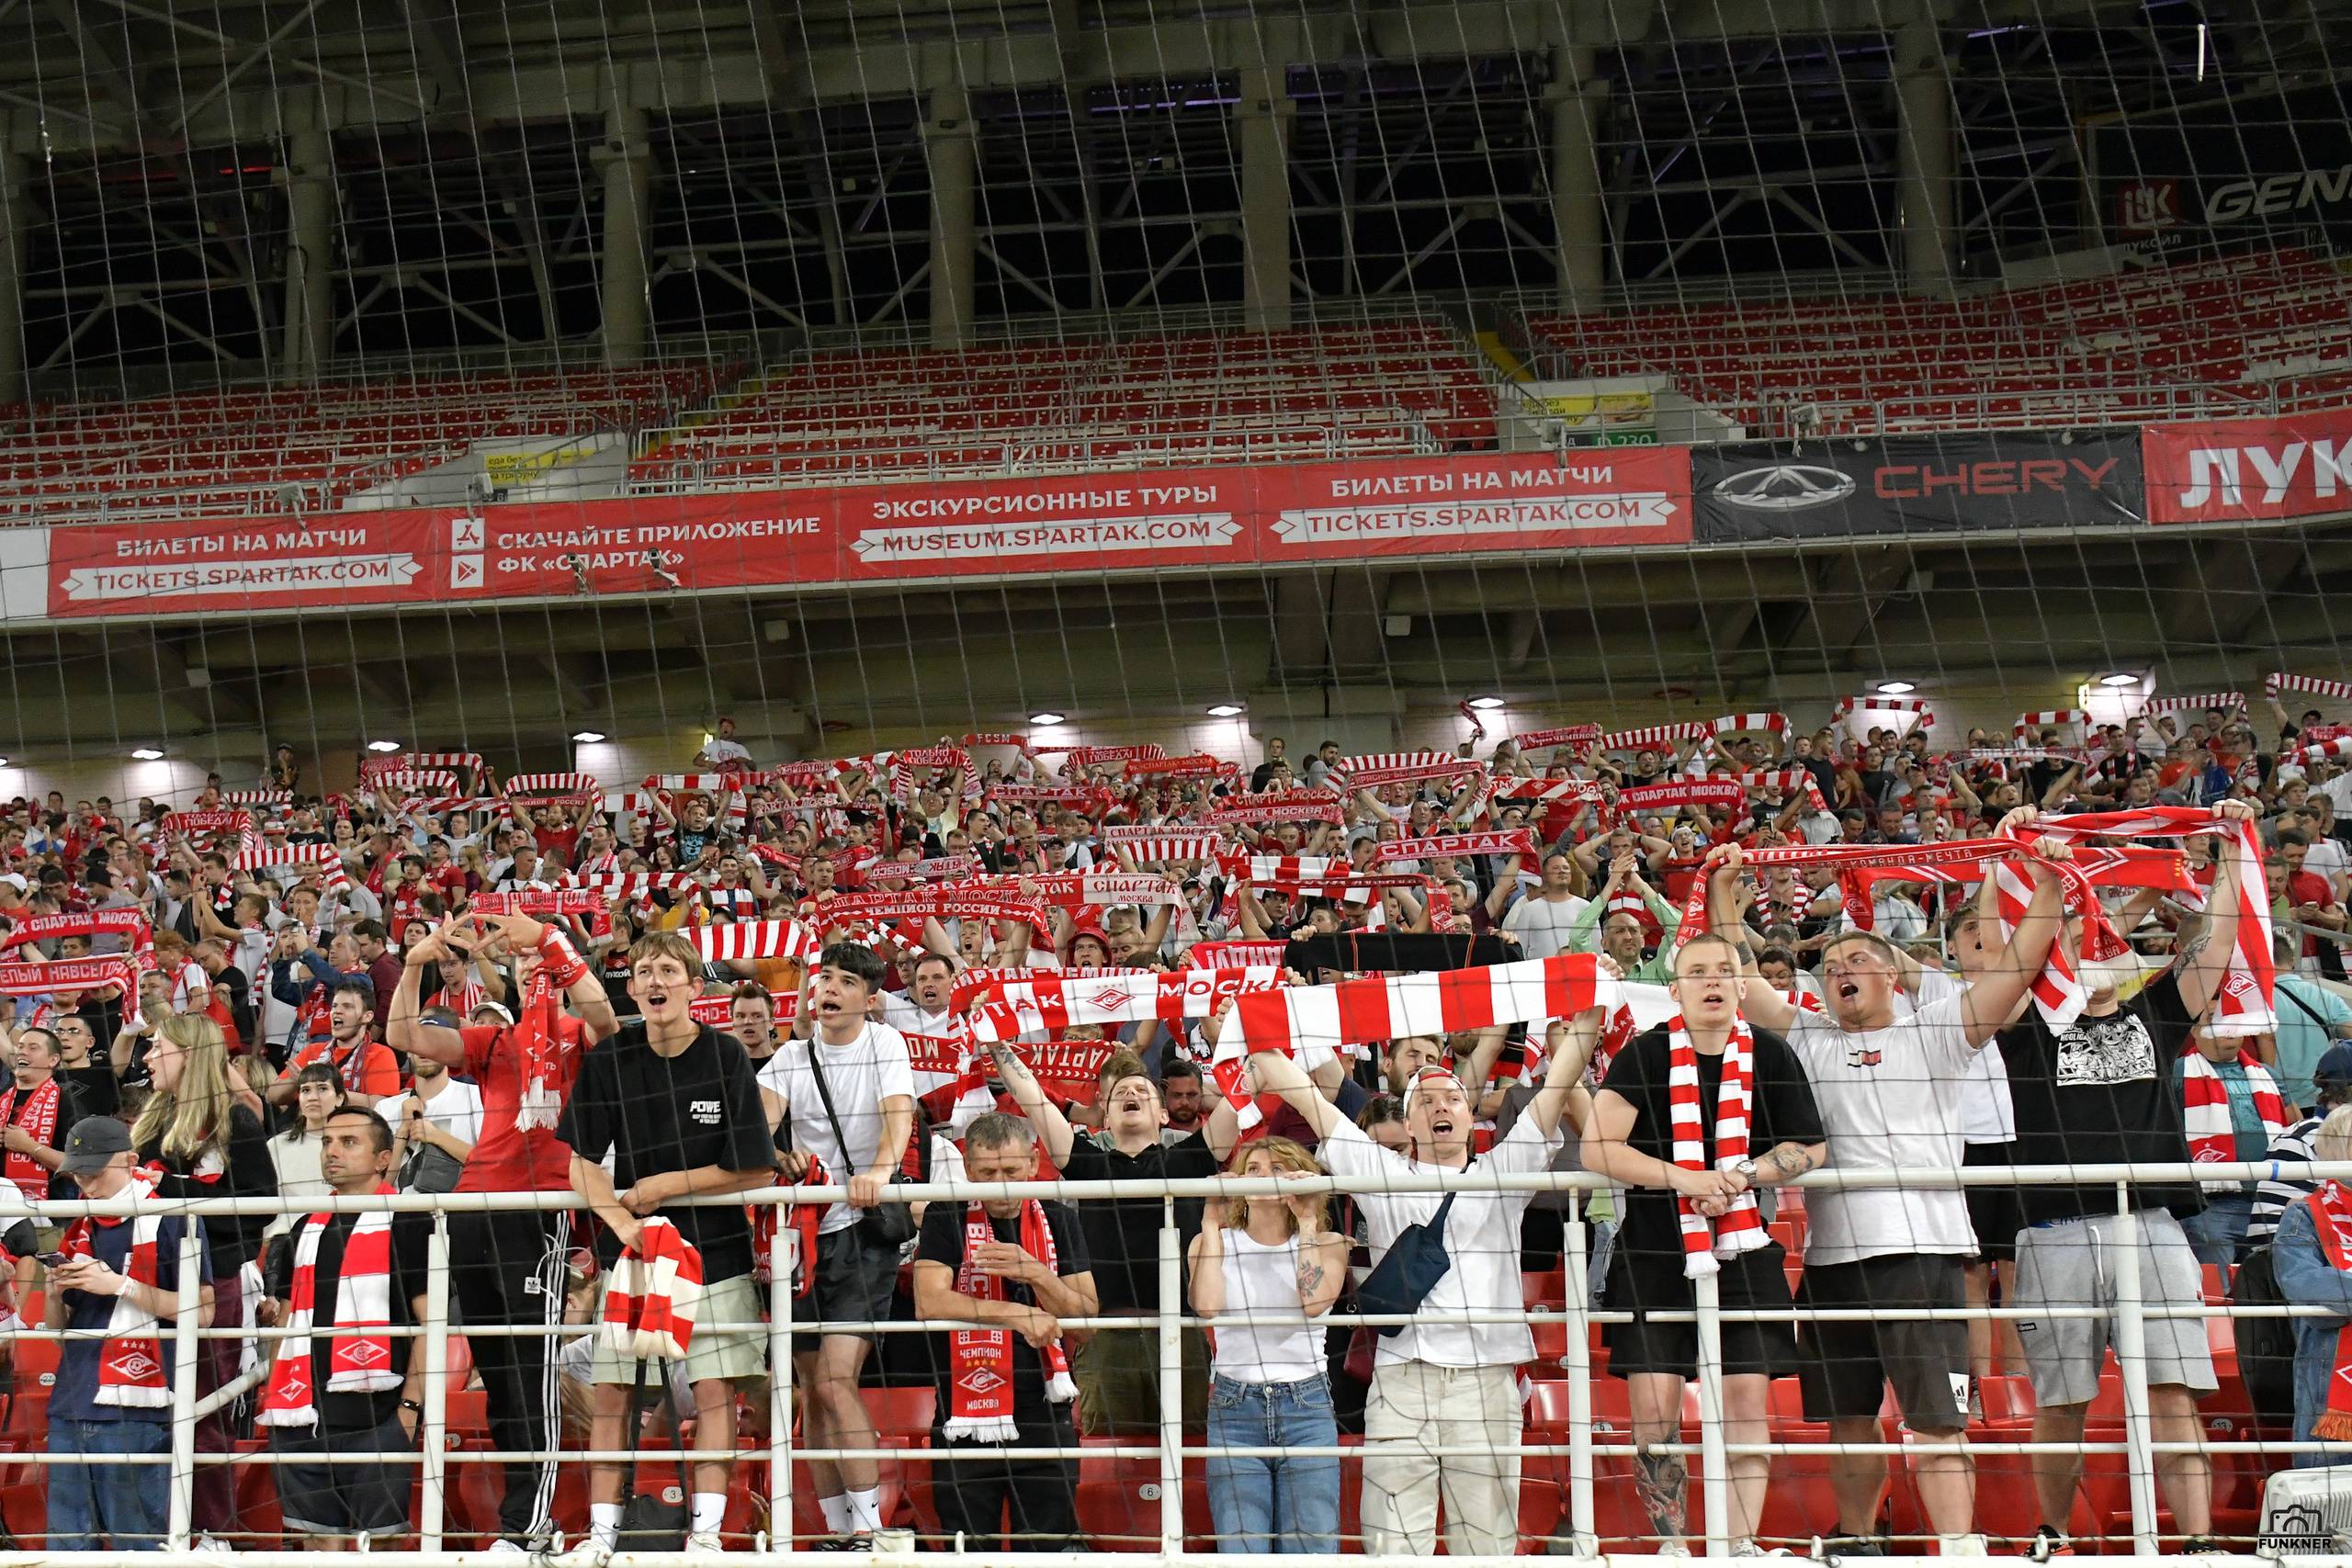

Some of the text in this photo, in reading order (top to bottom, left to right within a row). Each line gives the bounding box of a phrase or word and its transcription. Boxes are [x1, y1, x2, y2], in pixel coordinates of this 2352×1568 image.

[488, 456, 504, 465] еда
[1331, 466, 1613, 497] БИЛЕТЫ НА МАТЧИ
[1874, 457, 2120, 499] CHERY
[873, 485, 1217, 520] ЭКСКУРСИОННЫЕ ТУРЫ
[1307, 500, 1641, 533] TICKETS.SPARTAK.COM
[497, 515, 820, 551] СКАЧАЙТЕ ПРИЛОЖЕНИЕ
[882, 521, 1211, 553] MUSEUM.SPARTAK.COM
[116, 527, 367, 558] БИЛЕТЫ НА МАТЧИ
[497, 555, 537, 573] ФК
[95, 560, 390, 591] TICKETS.SPARTAK.COM
[992, 786, 1087, 799] СПАРТАК
[1237, 793, 1289, 806] СПАРТАК
[1633, 787, 1687, 801] СПАРТАК
[1690, 783, 1738, 797] МОСКВА
[1212, 809, 1267, 820] СПАРТАК
[1272, 807, 1323, 816] МОСКВА
[1110, 827, 1170, 837] СПАРТАК
[1381, 834, 1516, 856] СПАРТАК
[871, 864, 910, 878] MOSCO
[1093, 879, 1176, 894] СПАРТАК
[820, 890, 938, 910] СПАРТАК
[1117, 895, 1154, 904] МОСКВА
[865, 902, 1001, 916] ЧЕМПИОН РОССИИ
[30, 914, 94, 931] СПАРТАК
[36, 1090, 58, 1172] SPORTERS
[959, 1347, 1002, 1359] ЧЕМПИОН
[967, 1397, 1000, 1411] МОСКВА
[670, 1489, 676, 1499] 3
[1147, 1487, 1154, 1497] 6
